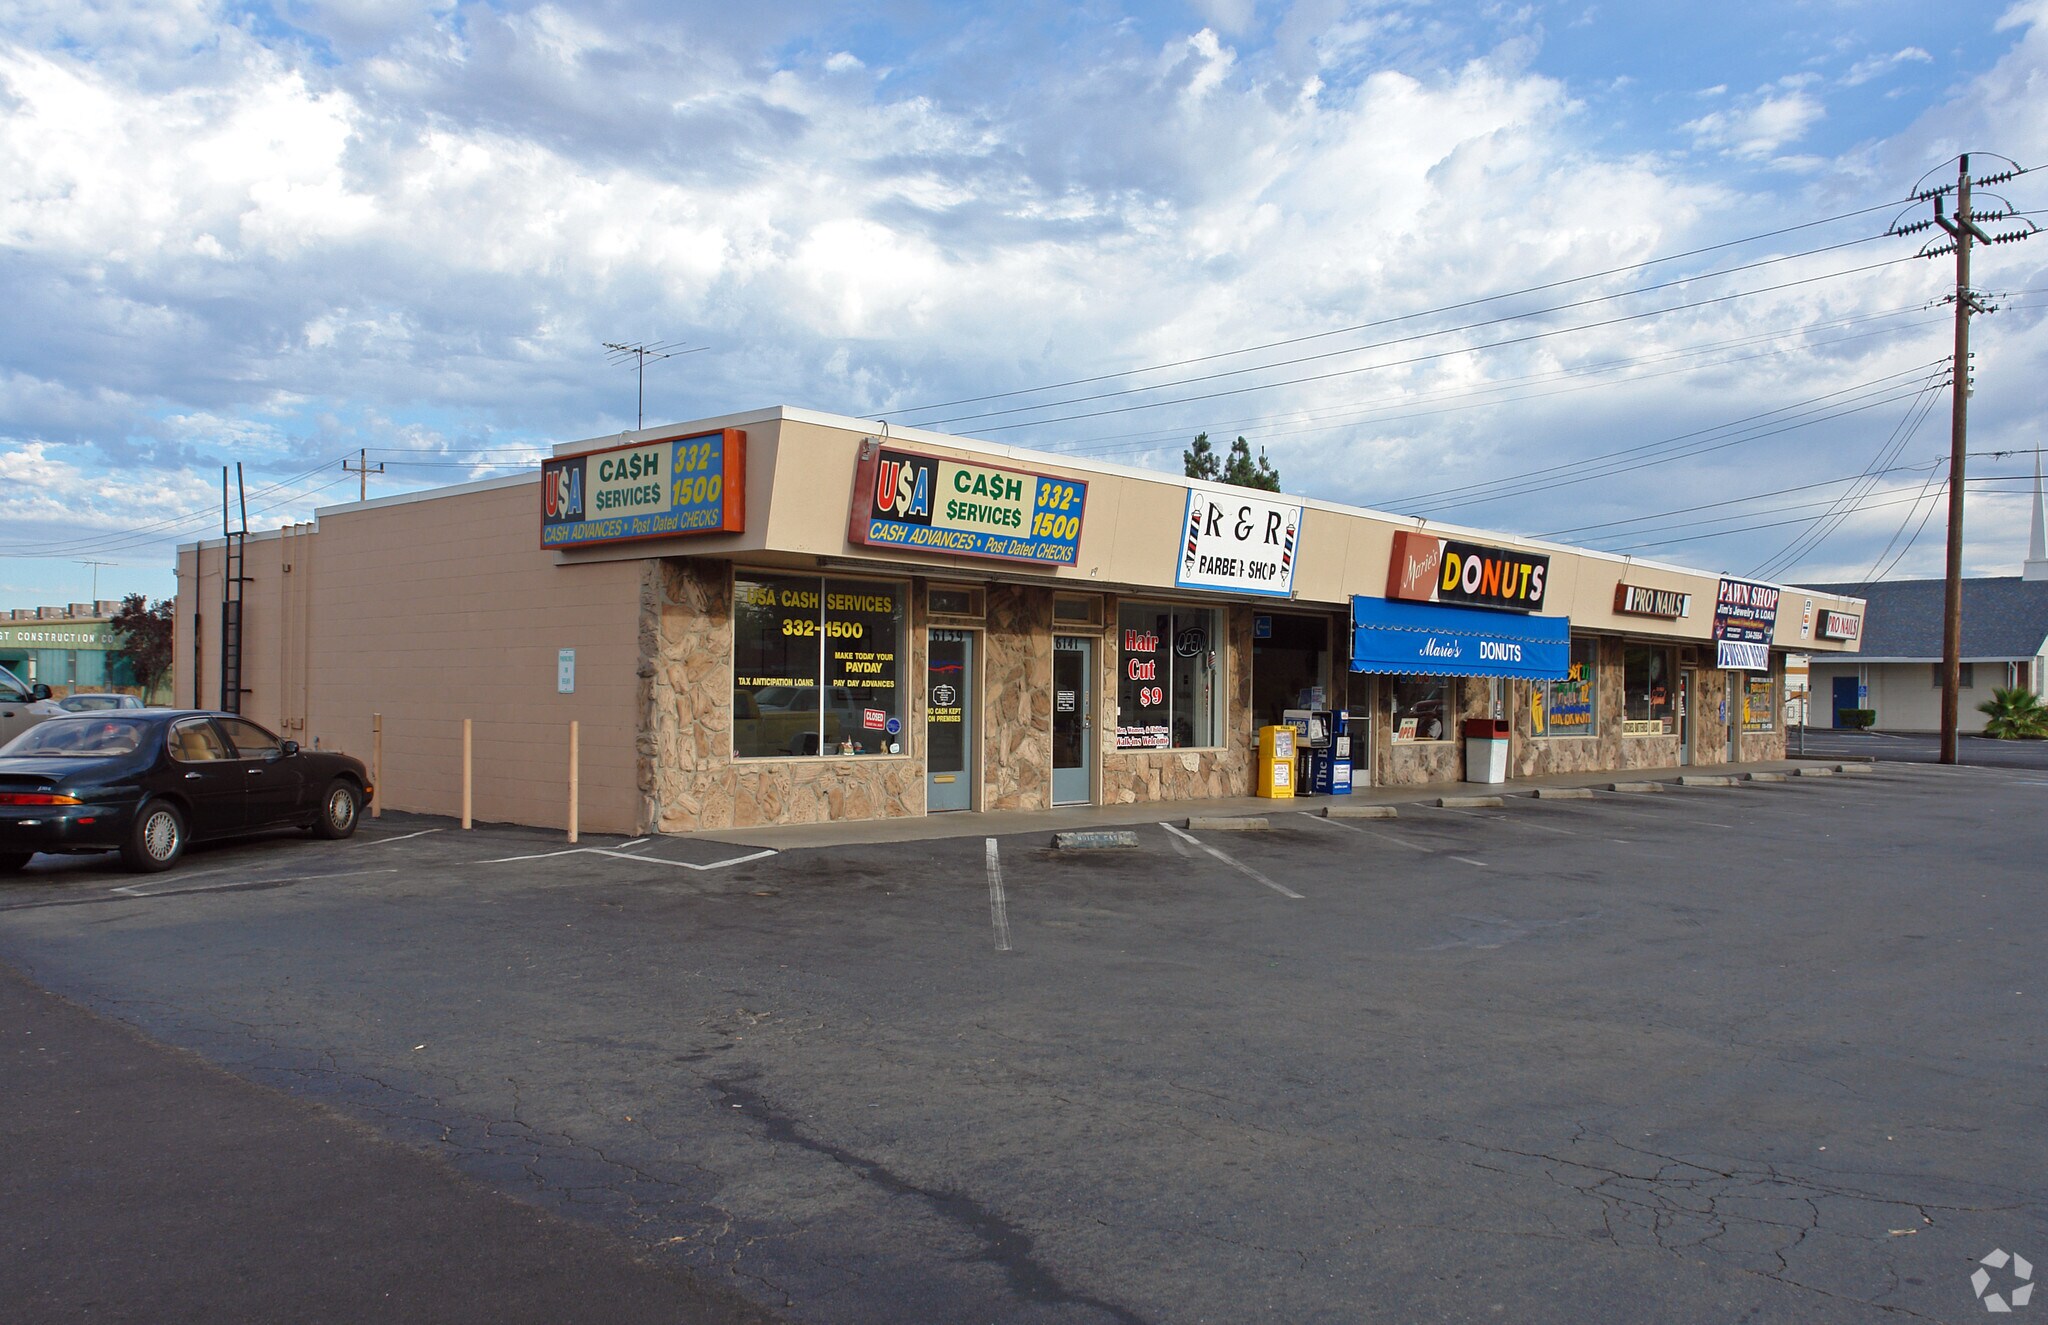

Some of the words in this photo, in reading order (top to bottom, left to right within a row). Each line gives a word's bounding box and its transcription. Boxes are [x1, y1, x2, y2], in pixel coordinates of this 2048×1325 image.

[674, 443, 719, 474] 332-
[672, 474, 721, 506] 1500
[1037, 483, 1080, 510] 332-
[544, 525, 569, 542] CASH
[572, 520, 622, 540] ADVANCES
[632, 517, 650, 534] Post
[653, 514, 678, 531] Dated
[680, 509, 719, 529] CHECKS
[1032, 513, 1079, 541] 1500
[1204, 502, 1224, 537] R
[1234, 506, 1254, 541] &
[1263, 510, 1282, 545] R
[869, 522, 908, 542] CASH
[908, 527, 975, 550] ADVANCES
[984, 537, 1007, 553] Post
[1007, 539, 1035, 557] Dated
[1036, 543, 1073, 561] CHECKS
[1403, 549, 1438, 591] Marie's
[1442, 552, 1545, 601] DONUTS
[747, 587, 776, 606] USA
[780, 590, 818, 609] CASH
[827, 594, 892, 613] SERVICES
[1633, 588, 1654, 612] PRO
[1655, 591, 1683, 615] NAILS
[1718, 581, 1751, 605] PAWN
[1751, 586, 1778, 609] SHOP
[1717, 603, 1733, 615] Jim's
[1733, 605, 1754, 620] Jewelry
[1755, 608, 1760, 618] &
[1760, 609, 1775, 620] LOAN
[933, 630, 963, 642] 6139
[1828, 615, 1840, 633] PRO
[1841, 618, 1857, 635] NAILS
[17, 632, 95, 643] CONSTRUCTION
[1056, 638, 1078, 649] 6141
[1125, 629, 1159, 652] Hair
[1178, 632, 1205, 651] OPEN
[835, 652, 853, 660] MAKE
[855, 652, 875, 661] TODAY
[876, 653, 894, 661] YOUR
[1420, 638, 1462, 658] Marie's
[1480, 641, 1521, 662] DONUTS
[845, 662, 883, 673] PAYDAY
[1128, 658, 1155, 680] Cut
[738, 677, 751, 686] TAX
[752, 677, 793, 687] ANTICIPATION
[794, 678, 814, 687] LOANS
[833, 679, 845, 687] PAY
[847, 679, 860, 687] DAY
[861, 680, 894, 688] ADVANCES
[1140, 687, 1162, 707] $9
[866, 711, 884, 722] CLOSED
[1142, 736, 1169, 746] Welcome
[1398, 727, 1415, 738] OPEN
[1316, 763, 1328, 789] The
